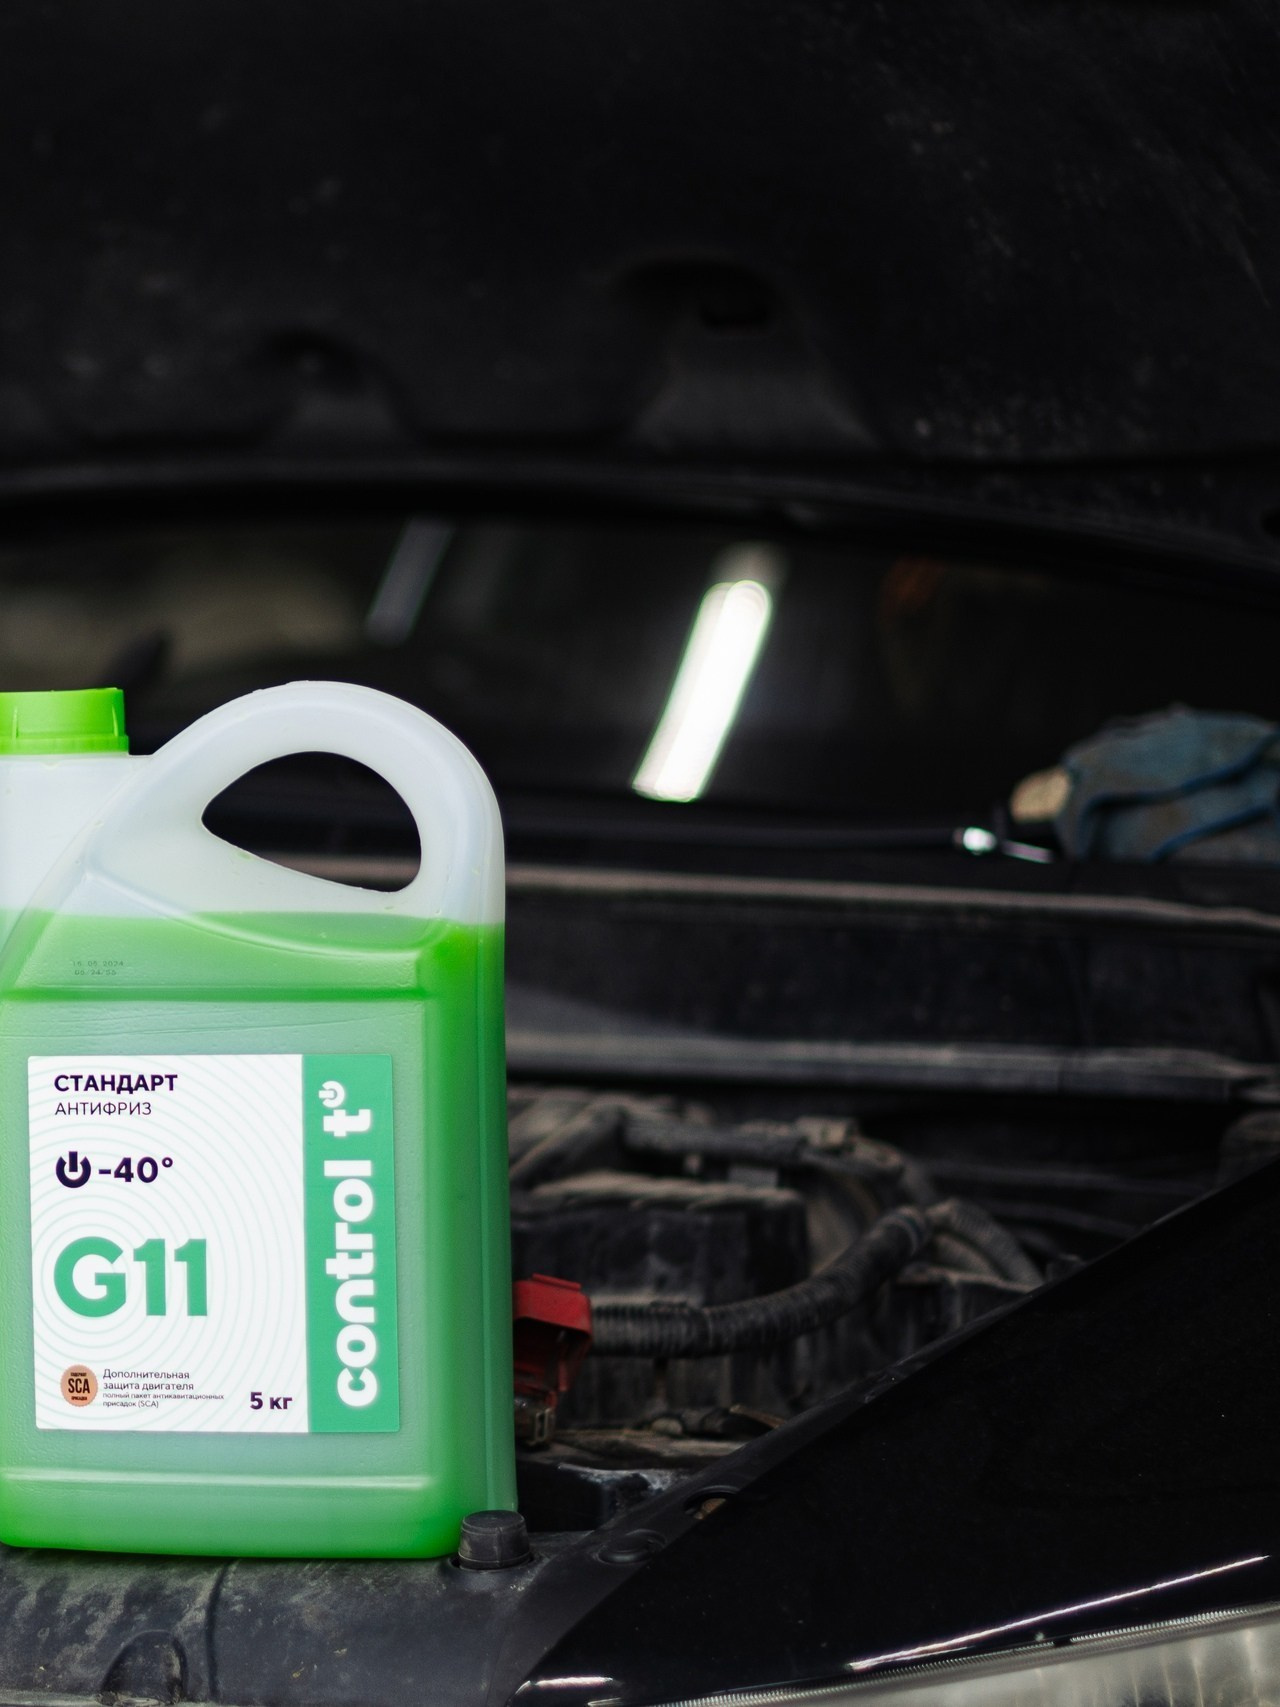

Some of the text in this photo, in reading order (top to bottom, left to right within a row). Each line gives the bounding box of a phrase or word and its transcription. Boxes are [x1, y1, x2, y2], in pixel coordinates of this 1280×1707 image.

[54, 1074, 178, 1094] СТАНДАРТ
[54, 1102, 152, 1116] АНТИФРИЗ
[98, 1156, 174, 1183] -40°
[53, 1236, 208, 1318] G11
[324, 1160, 378, 1407] control
[103, 1368, 190, 1380] Дополнительная
[68, 1378, 90, 1394] SCA
[103, 1382, 194, 1391] защита двигателя
[138, 1401, 159, 1409] (SCA)
[250, 1392, 293, 1410] 5 кг
